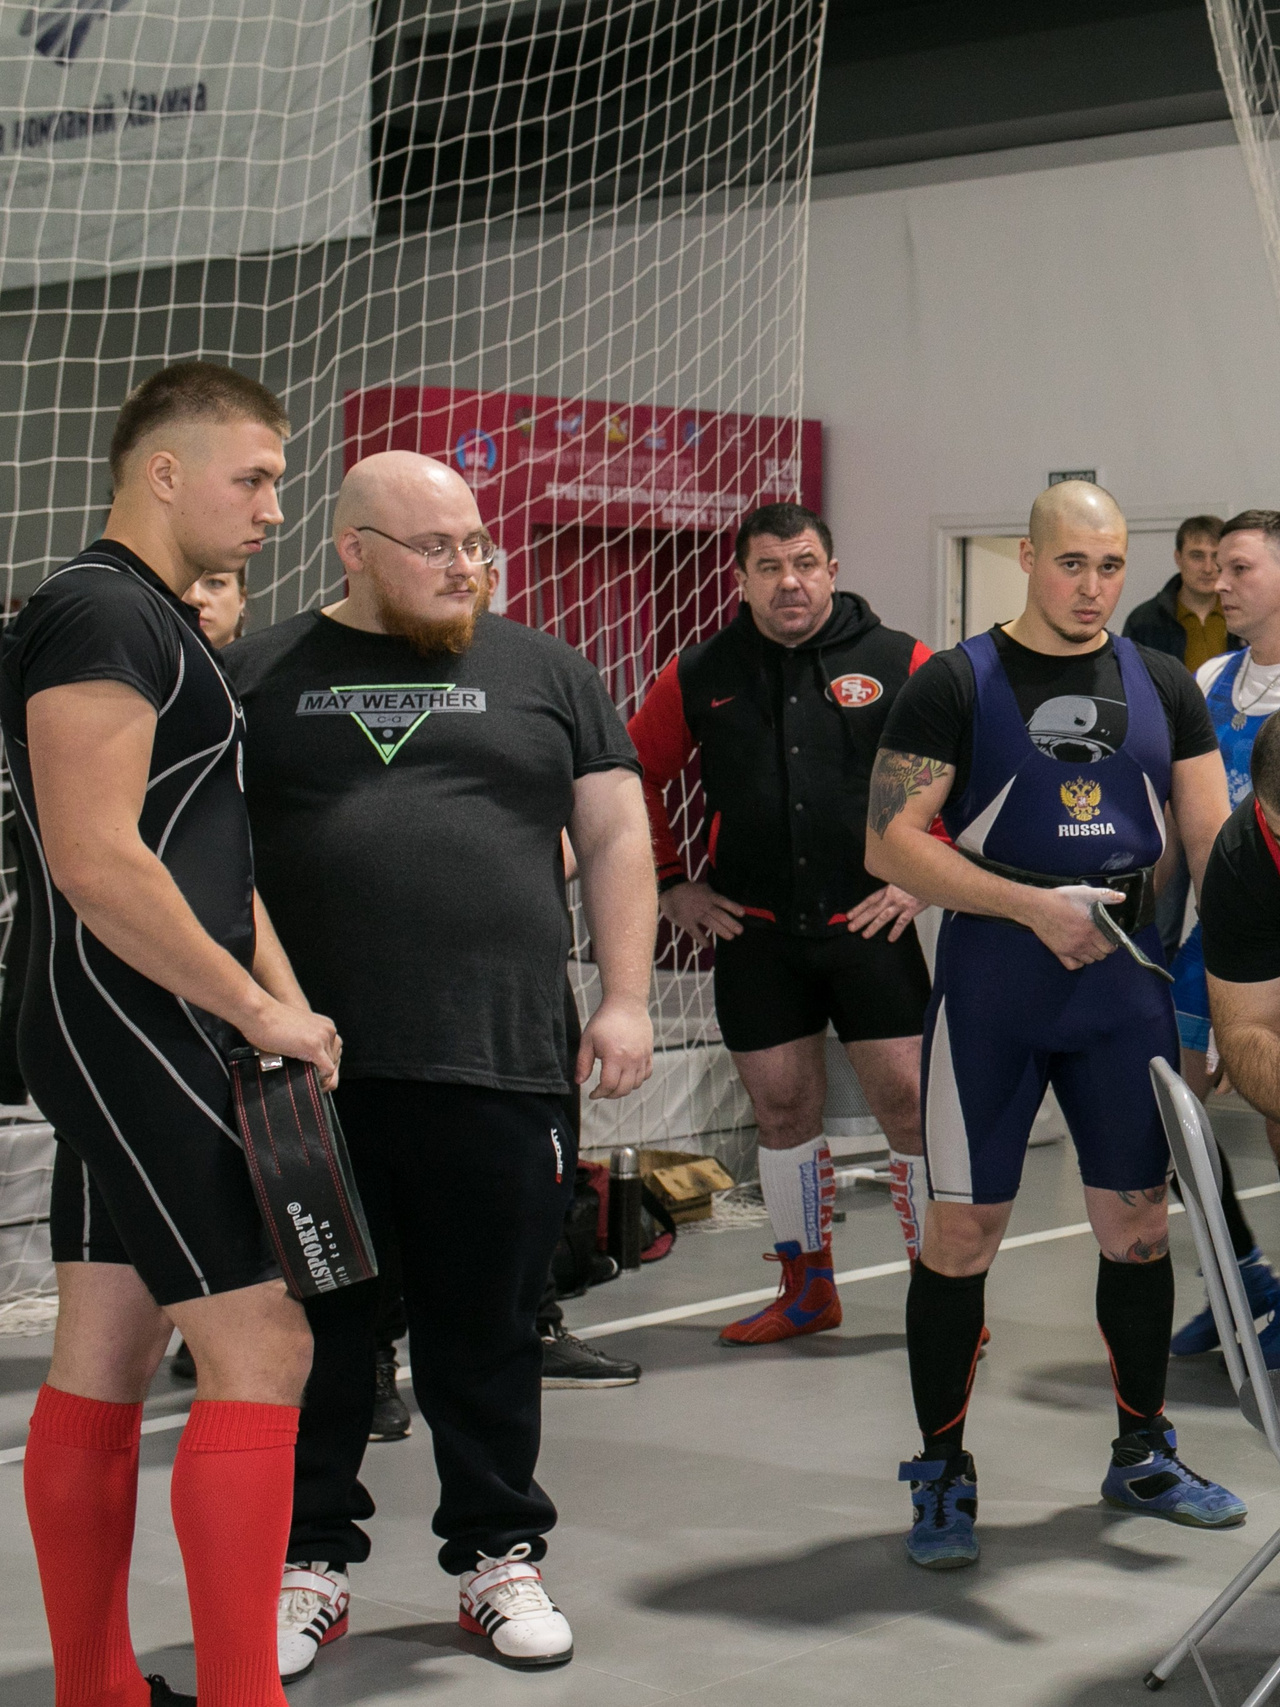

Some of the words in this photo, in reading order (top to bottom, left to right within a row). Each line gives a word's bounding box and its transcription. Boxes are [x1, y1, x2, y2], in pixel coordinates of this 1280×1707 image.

[304, 694, 354, 710] MAY
[363, 692, 478, 709] WEATHER
[1057, 822, 1117, 838] RUSSIA
